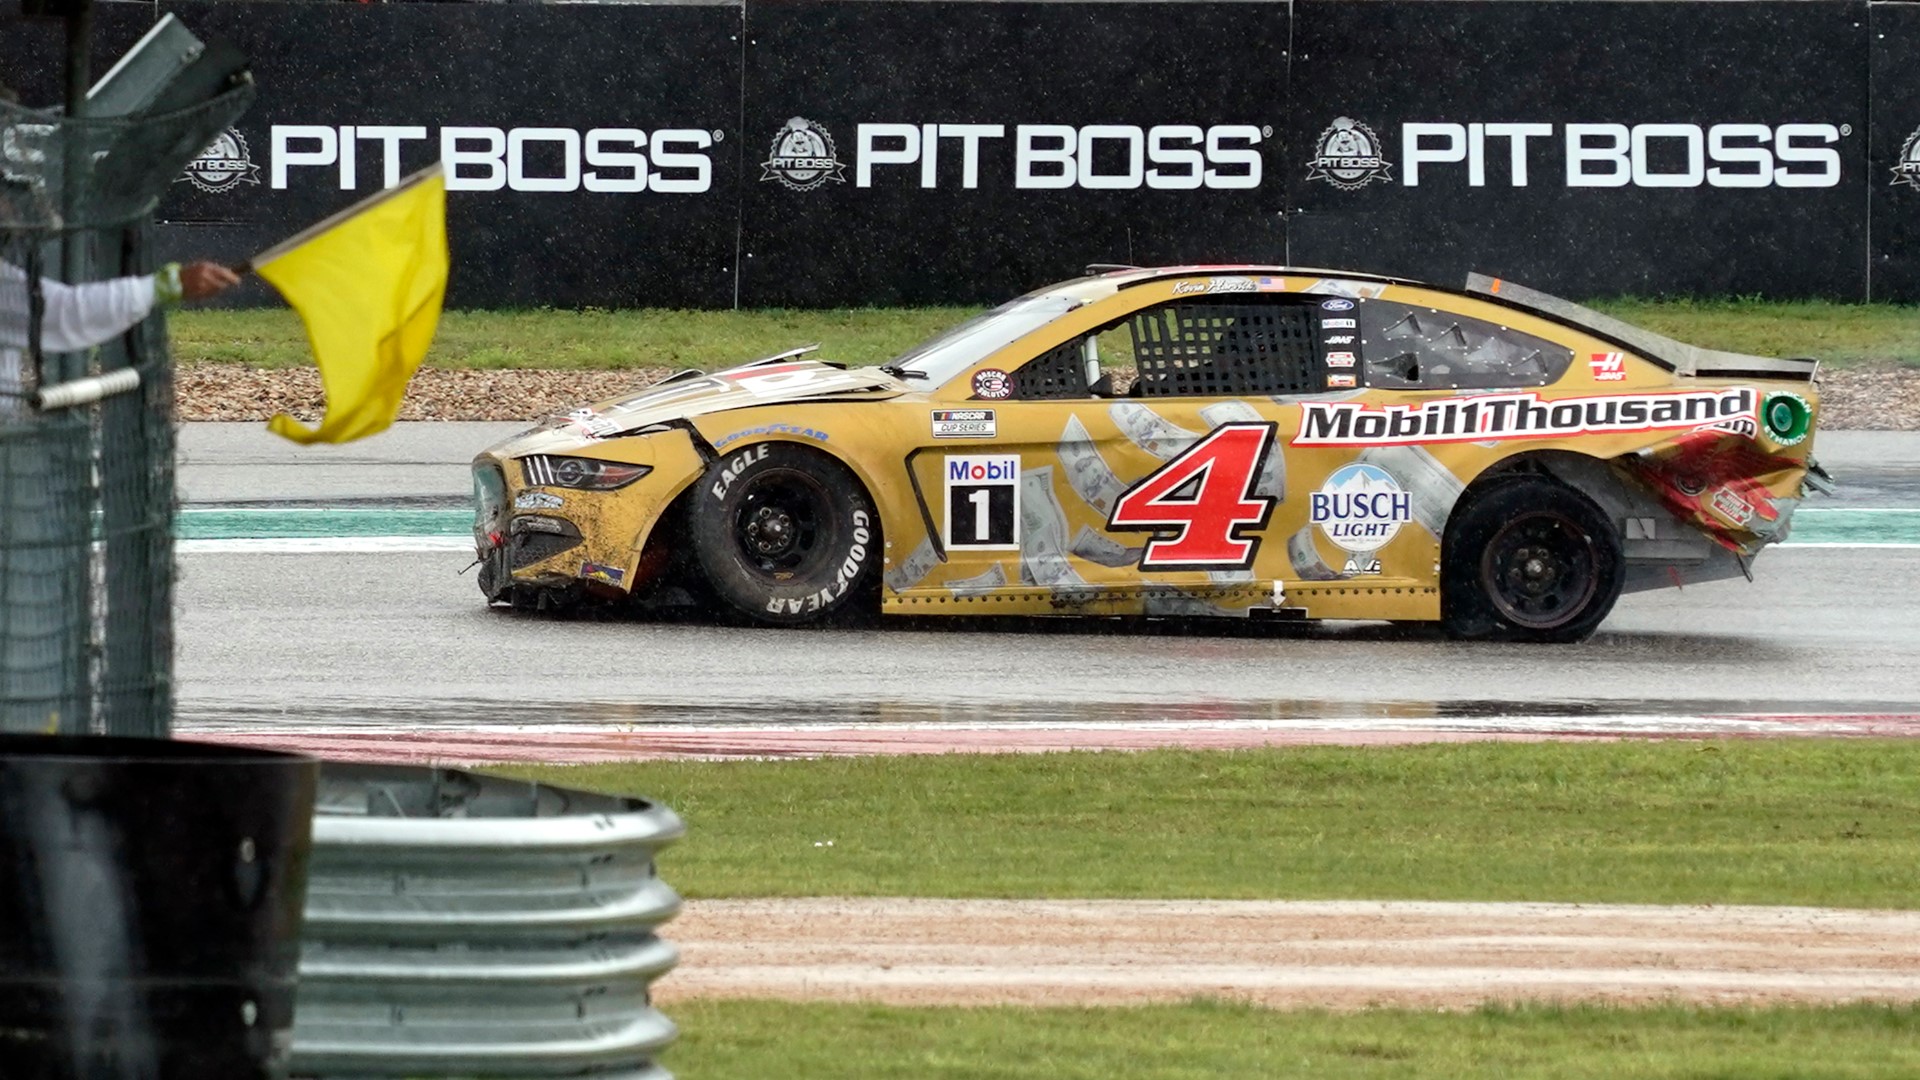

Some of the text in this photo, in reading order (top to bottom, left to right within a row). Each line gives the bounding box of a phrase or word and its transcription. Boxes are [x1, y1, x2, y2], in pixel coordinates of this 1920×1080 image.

[207, 160, 247, 170] BOSS
[271, 125, 712, 193] PIT BOSS
[772, 158, 834, 169] PIT BOSS
[857, 124, 1262, 190] PIT BOSS
[1318, 157, 1380, 168] PIT BOSS
[1403, 123, 1841, 188] PIT BOSS
[713, 423, 829, 449] GOODYEAR
[941, 423, 987, 432] CUP SERIES
[712, 443, 770, 501] EAGLE
[950, 460, 1015, 480] Mobil
[1107, 422, 1278, 572] 4
[1311, 492, 1410, 521] BUSCH
[968, 489, 989, 541] 1
[1332, 523, 1391, 537] LIGHT
